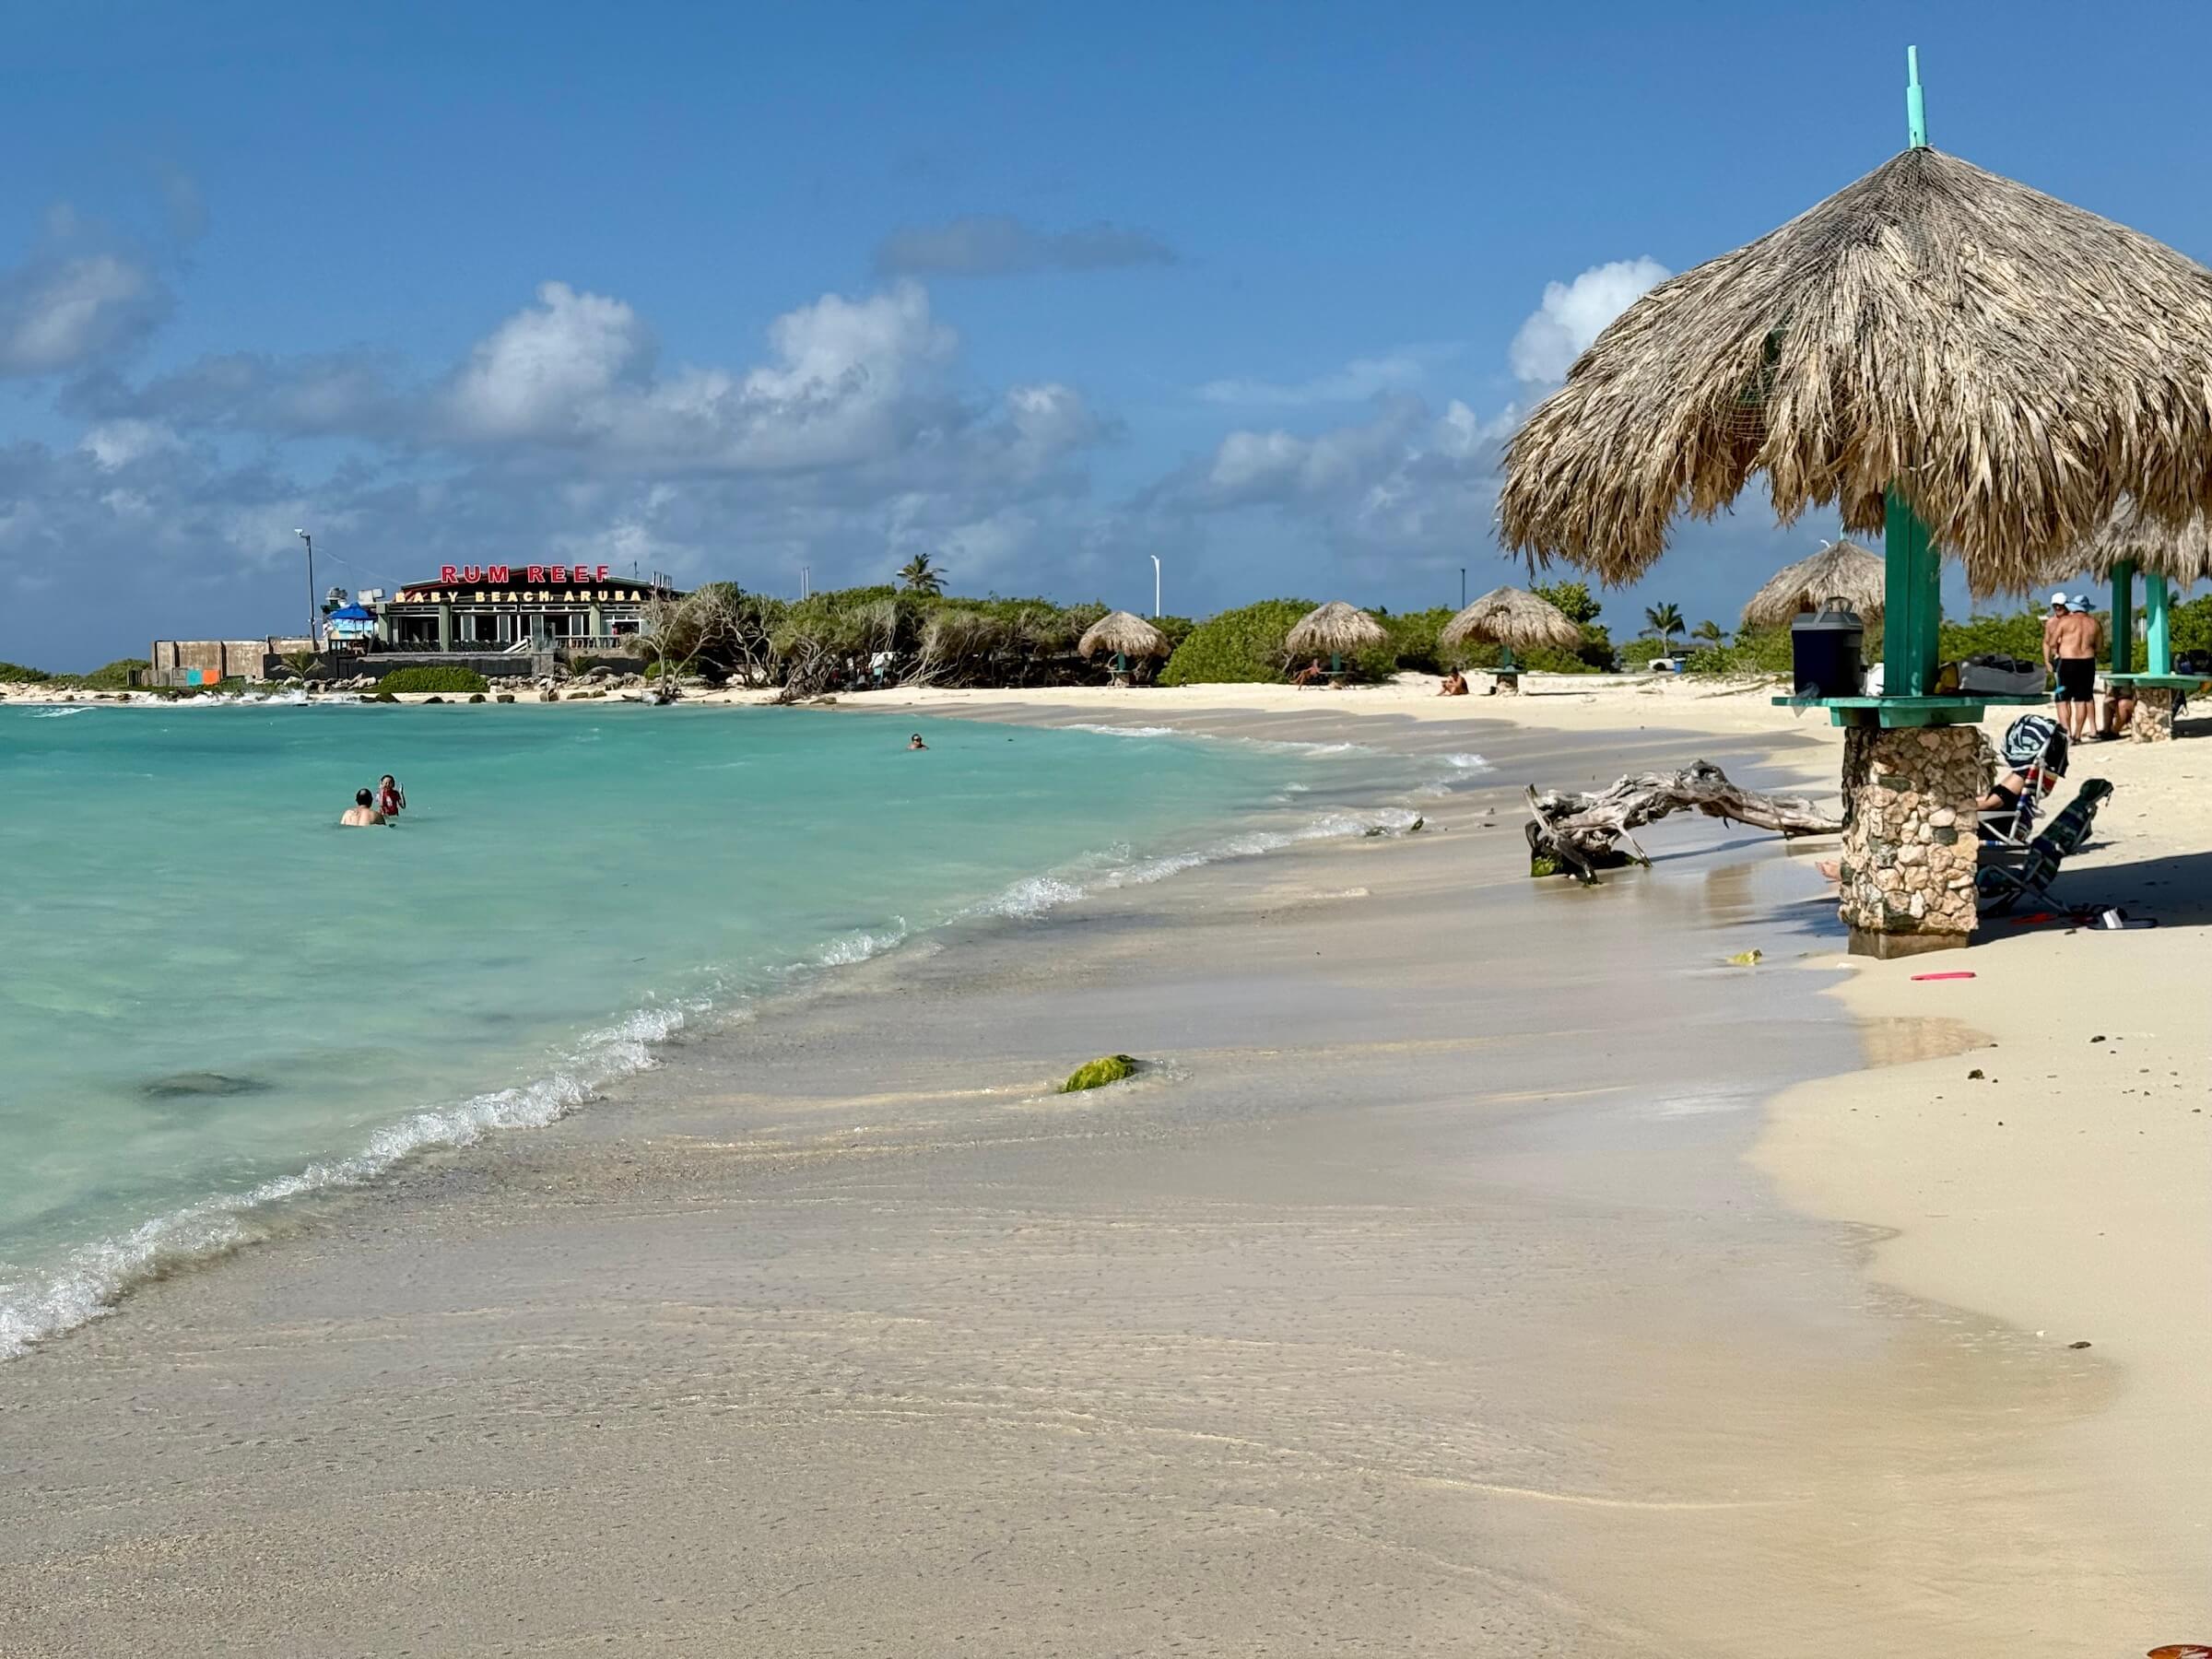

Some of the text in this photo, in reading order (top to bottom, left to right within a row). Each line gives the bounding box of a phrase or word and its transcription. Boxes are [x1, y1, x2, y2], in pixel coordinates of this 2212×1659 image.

[441, 564, 610, 583] RUM REEF
[395, 590, 641, 603] BABY BEACH, ARUBA
